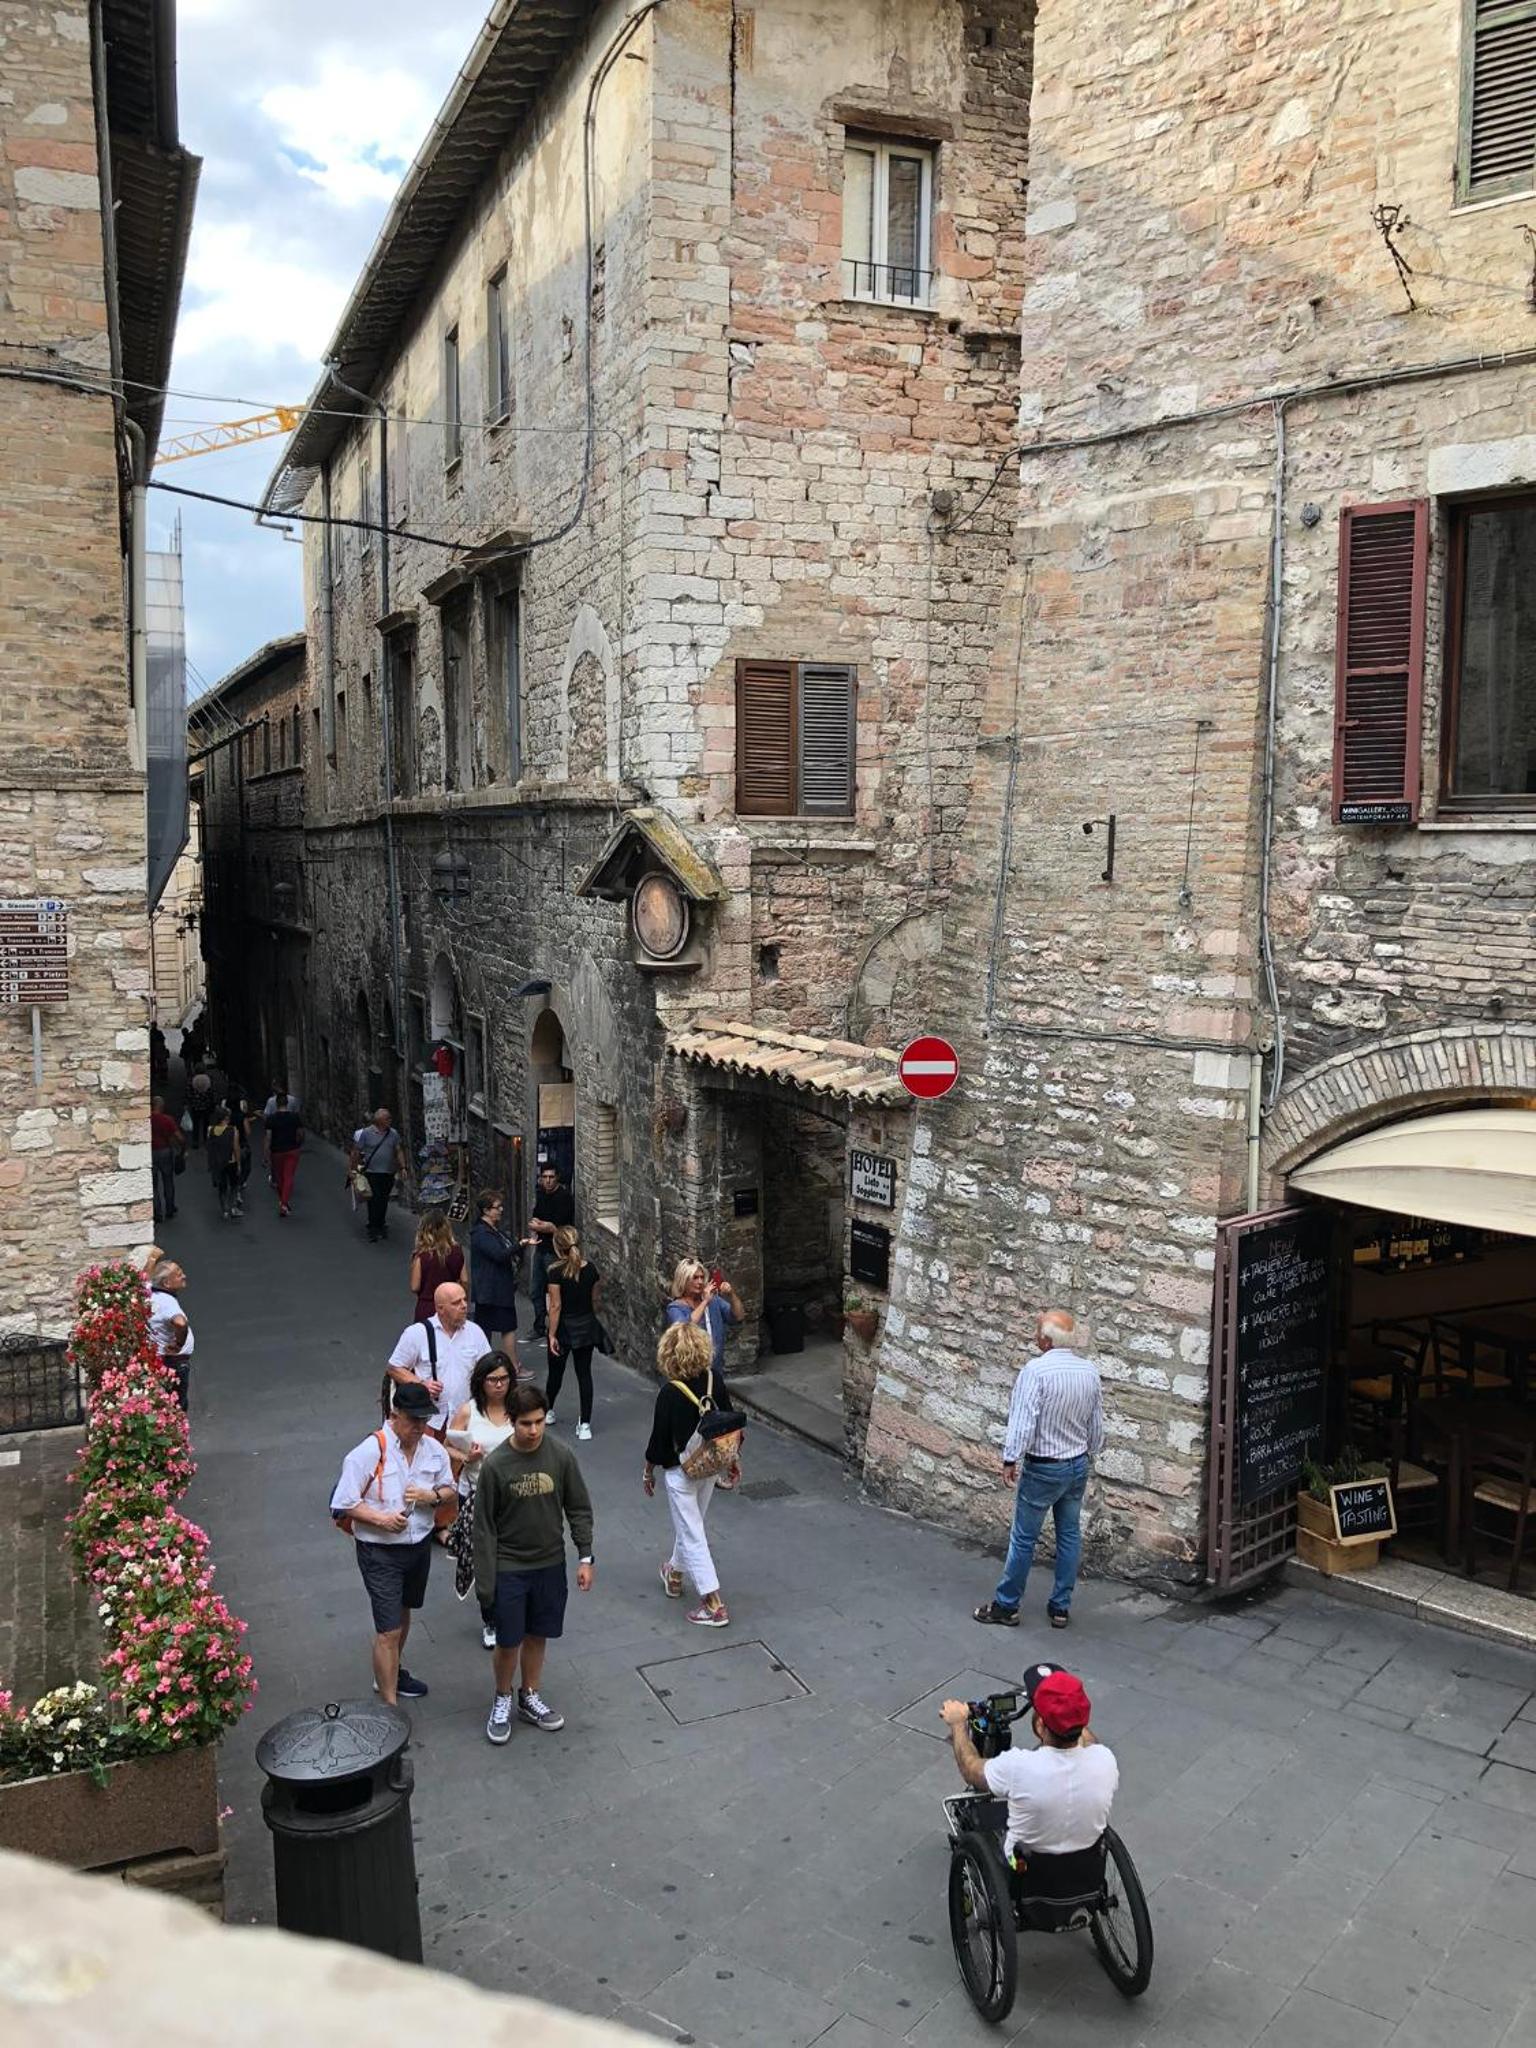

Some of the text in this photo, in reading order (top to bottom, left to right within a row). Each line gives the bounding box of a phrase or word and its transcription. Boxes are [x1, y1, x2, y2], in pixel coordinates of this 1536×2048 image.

[854, 1152, 891, 1178] HOTEL
[865, 1175, 880, 1188] Lieto
[856, 1184, 887, 1201] Soggiorno
[510, 1480, 538, 1489] NORTH
[522, 1473, 538, 1481] THE
[1339, 1489, 1373, 1506] WINE
[1339, 1505, 1387, 1528] TASTING
